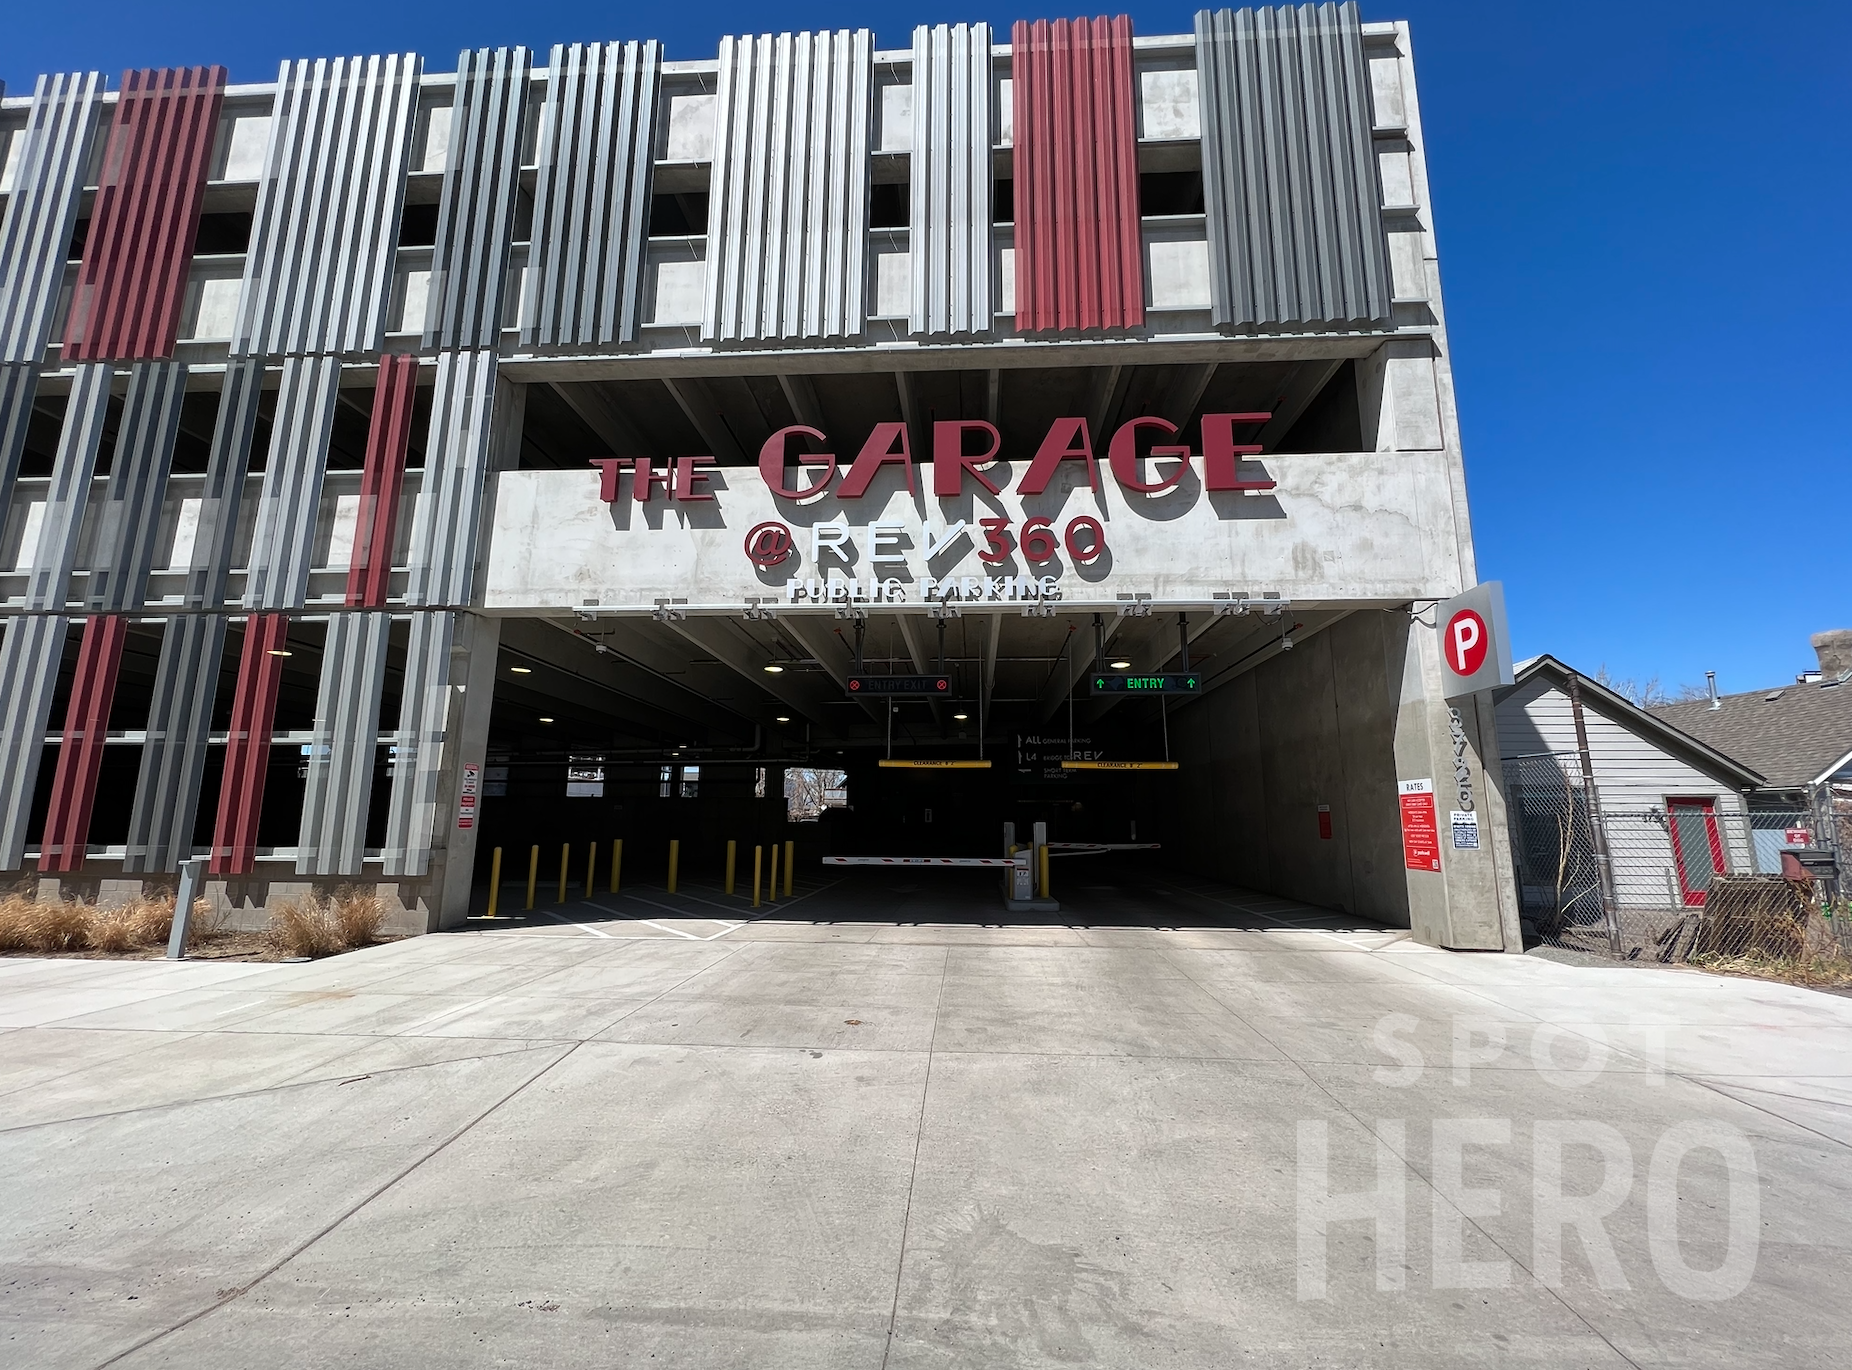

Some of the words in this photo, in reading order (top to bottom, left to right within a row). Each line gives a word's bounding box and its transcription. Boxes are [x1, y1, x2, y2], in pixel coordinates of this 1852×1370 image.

[589, 456, 716, 503] THE
[758, 412, 1277, 498] GARAGE
[786, 577, 903, 599] PUBLIC
[920, 575, 1060, 598] PARKING
[1454, 617, 1479, 671] P
[868, 679, 900, 691] ENTRY
[903, 679, 928, 690] EXIT
[1126, 677, 1165, 689] ENTRY
[1025, 736, 1042, 745] ALL
[1025, 752, 1038, 761] L4
[1406, 782, 1424, 791] RATES
